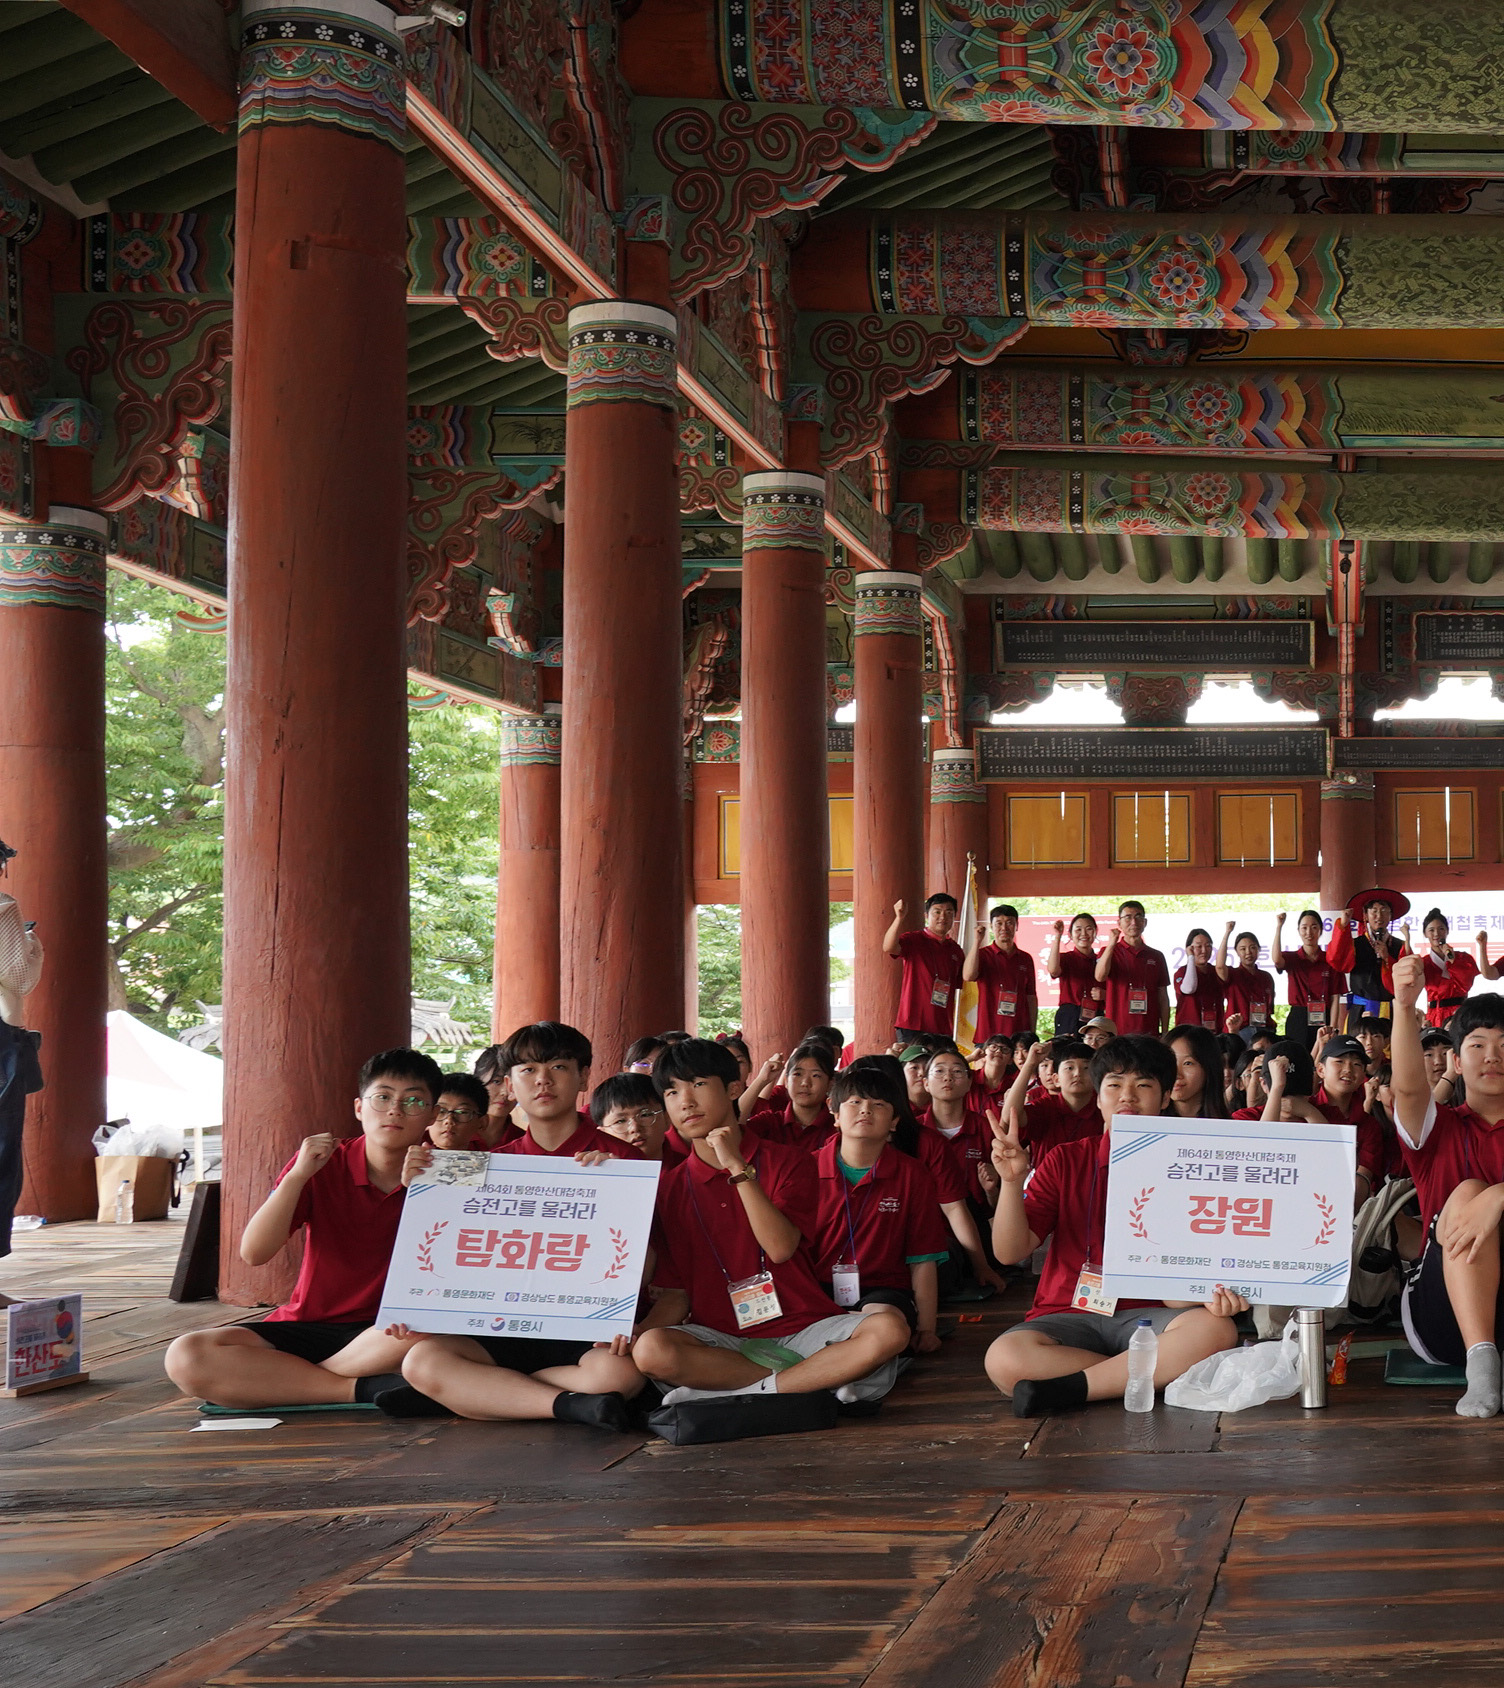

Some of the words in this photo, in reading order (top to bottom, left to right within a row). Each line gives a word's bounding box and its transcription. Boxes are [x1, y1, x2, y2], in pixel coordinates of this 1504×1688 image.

[1176, 1148, 1213, 1160] 제64회
[1215, 1149, 1297, 1164] 통영한산대첩축제
[1166, 1162, 1239, 1183] 승전고를
[1243, 1166, 1300, 1186] 울려라
[514, 1184, 597, 1199] 통영한산대첩축제
[462, 1197, 538, 1218] 승전고를
[541, 1200, 598, 1220] 울려라
[1187, 1195, 1273, 1237] 장원
[455, 1228, 592, 1272] 탐화랑
[1127, 1254, 1142, 1263] 주관
[1160, 1255, 1212, 1267] 통영문화재단
[1237, 1258, 1271, 1269] 경상남도
[1272, 1260, 1332, 1272] 통영교육지원청
[408, 1287, 425, 1297] 주관
[442, 1288, 496, 1301] 통영문화재단
[520, 1293, 556, 1304] 경상남도
[557, 1294, 618, 1306] 통영교육지원청
[1188, 1284, 1206, 1295] 주최
[467, 1318, 485, 1328] 주최
[507, 1319, 544, 1333] 통영시
